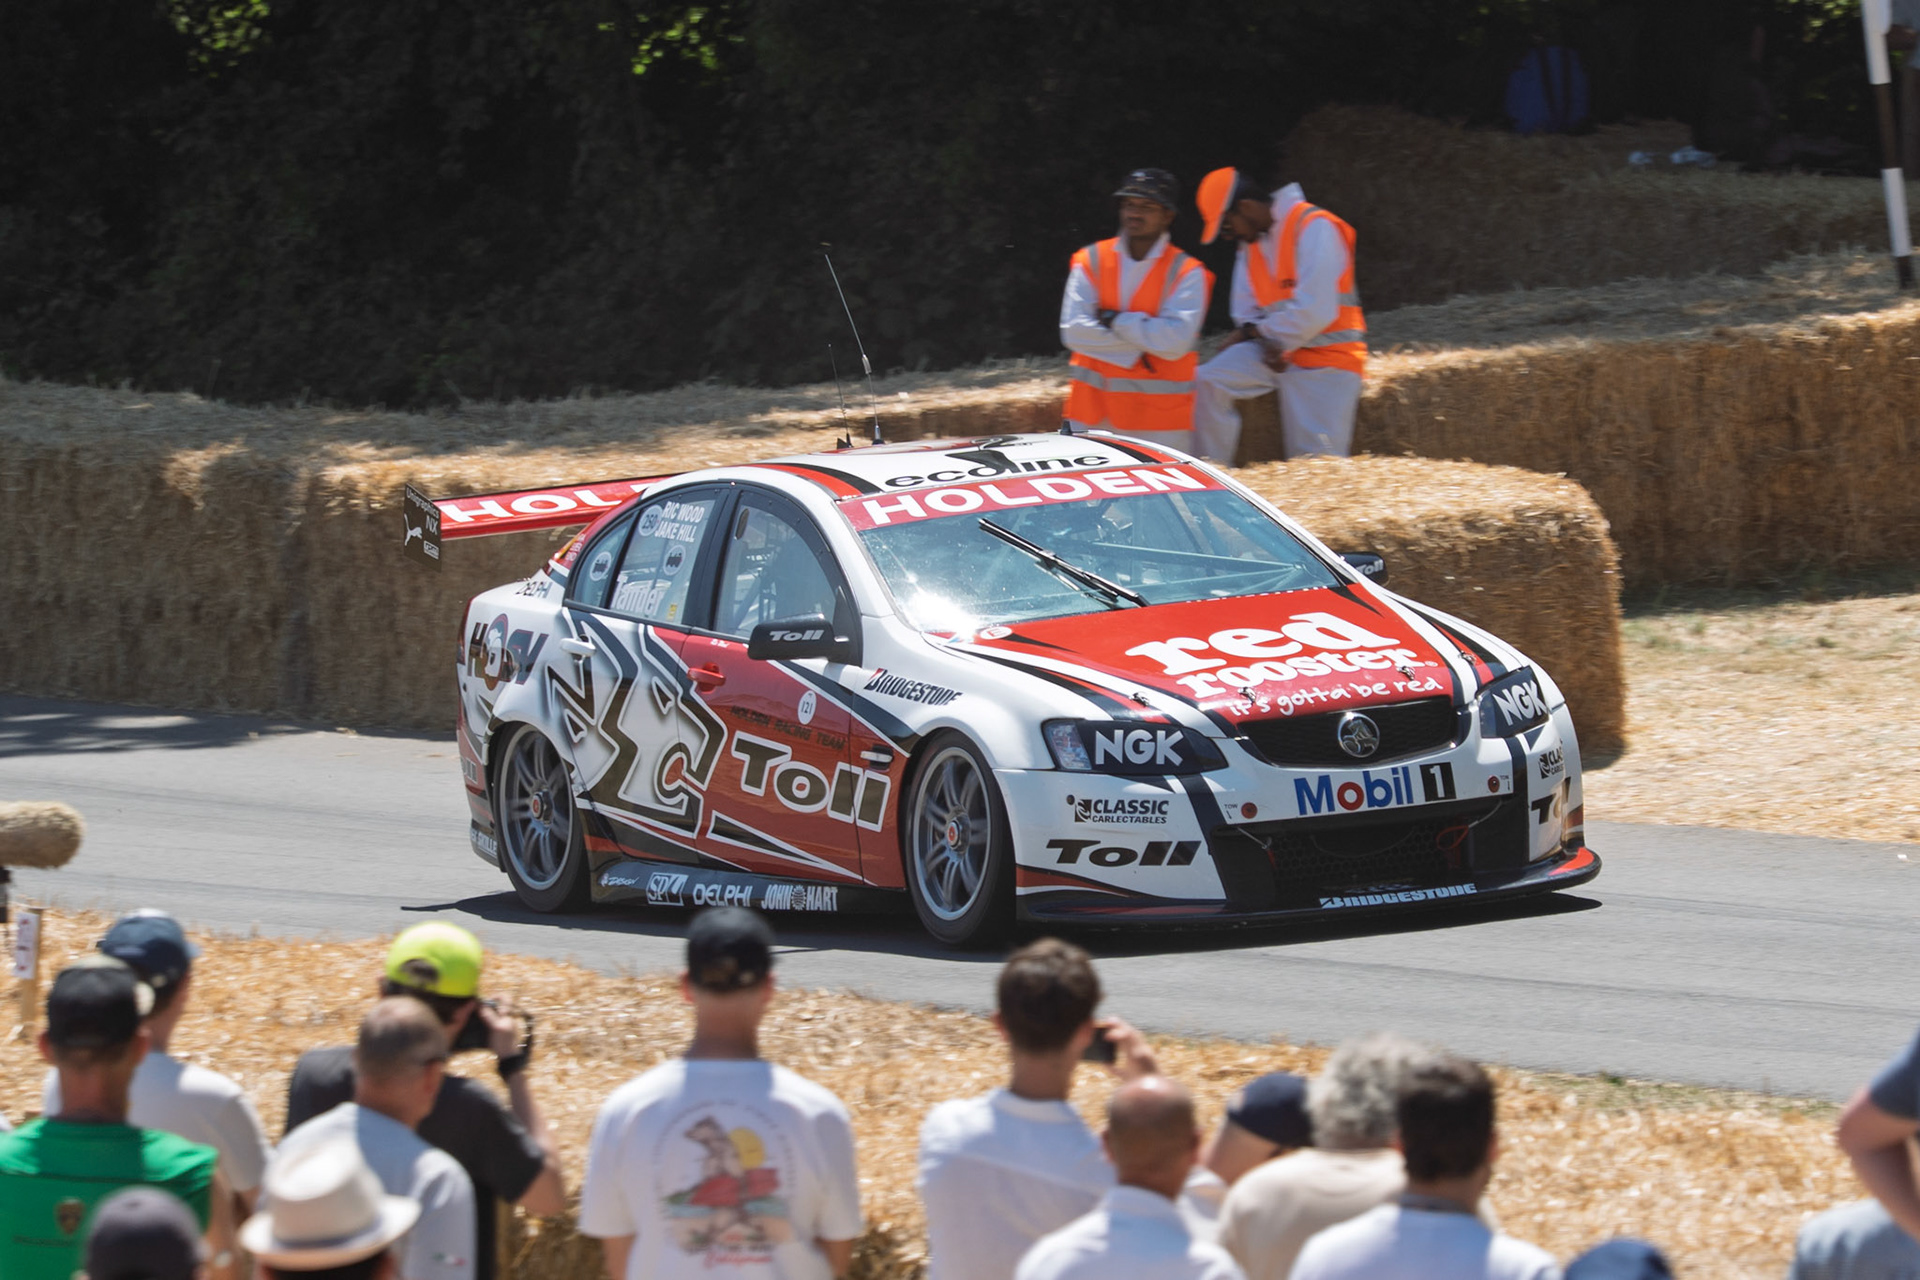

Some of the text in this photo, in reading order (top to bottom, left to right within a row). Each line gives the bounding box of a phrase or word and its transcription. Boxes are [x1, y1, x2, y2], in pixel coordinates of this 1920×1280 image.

[441, 485, 650, 522] HOL
[661, 501, 705, 523] RIC WOOD
[863, 467, 1206, 526] HOLDEN
[425, 515, 439, 535] NX
[655, 521, 697, 543] JAKE HILL
[769, 629, 825, 642] Toll
[1125, 612, 1400, 675] red
[863, 667, 964, 706] BRIDGESTONE
[1177, 648, 1426, 698] rooster
[801, 701, 813, 714] 121
[1277, 684, 1352, 716] gotta
[1350, 682, 1391, 698] be
[1393, 677, 1444, 692] red
[1494, 679, 1548, 726] NGK
[775, 719, 812, 740] RACING
[817, 732, 846, 750] TEAM
[1095, 729, 1184, 766] NGK
[731, 730, 891, 832] Toll
[1294, 765, 1446, 816] Mobil 1
[1092, 799, 1169, 815] CLASSIC
[1092, 815, 1167, 824] CARLECTABLES
[1046, 839, 1201, 867] Toll
[761, 884, 838, 911] JOHN HART
[1320, 883, 1477, 909] BRIDGESTONE
